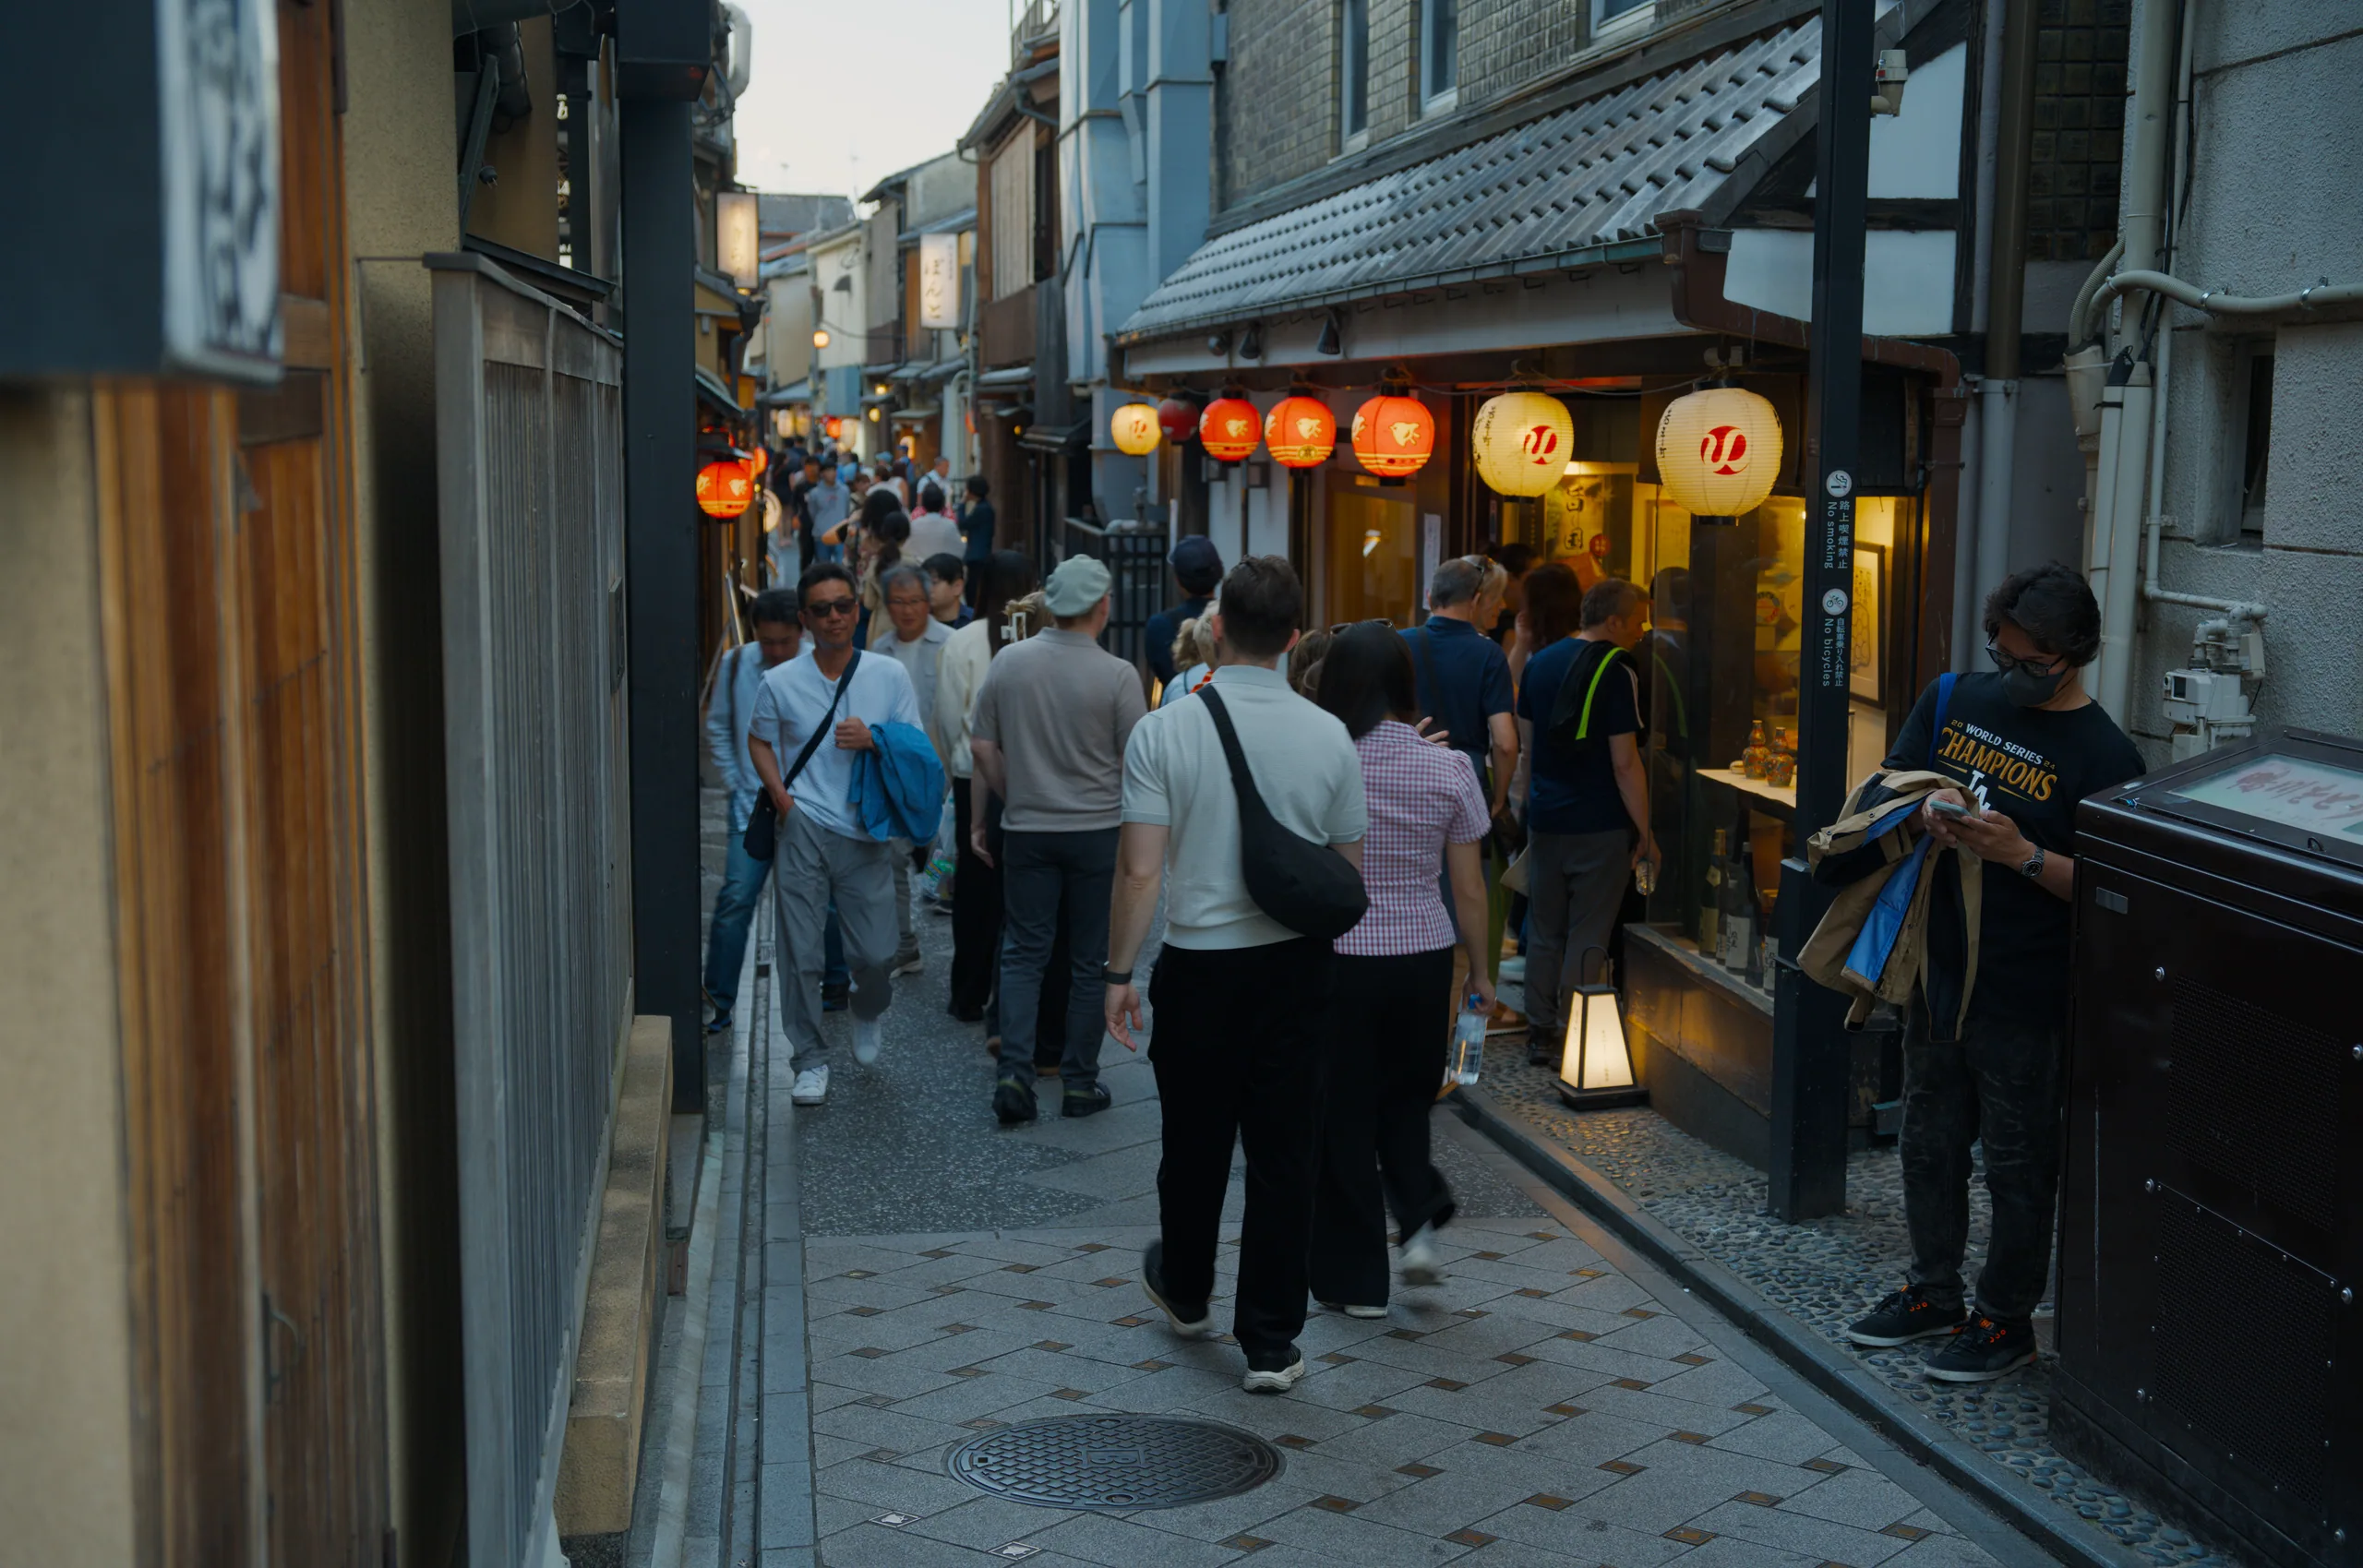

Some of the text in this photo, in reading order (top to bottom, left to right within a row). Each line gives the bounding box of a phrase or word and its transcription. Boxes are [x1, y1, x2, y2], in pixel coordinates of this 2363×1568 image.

[1824, 501, 1838, 569] No smoking
[1837, 500, 1851, 569] 路上喫煙禁止
[1821, 618, 1834, 687] No bicycles
[1835, 617, 1845, 687] 自転車乗り入れ禁止
[1937, 726, 2058, 801] CHAMPIONS
[1950, 719, 2056, 770] 20 WORLD SERIES 24
